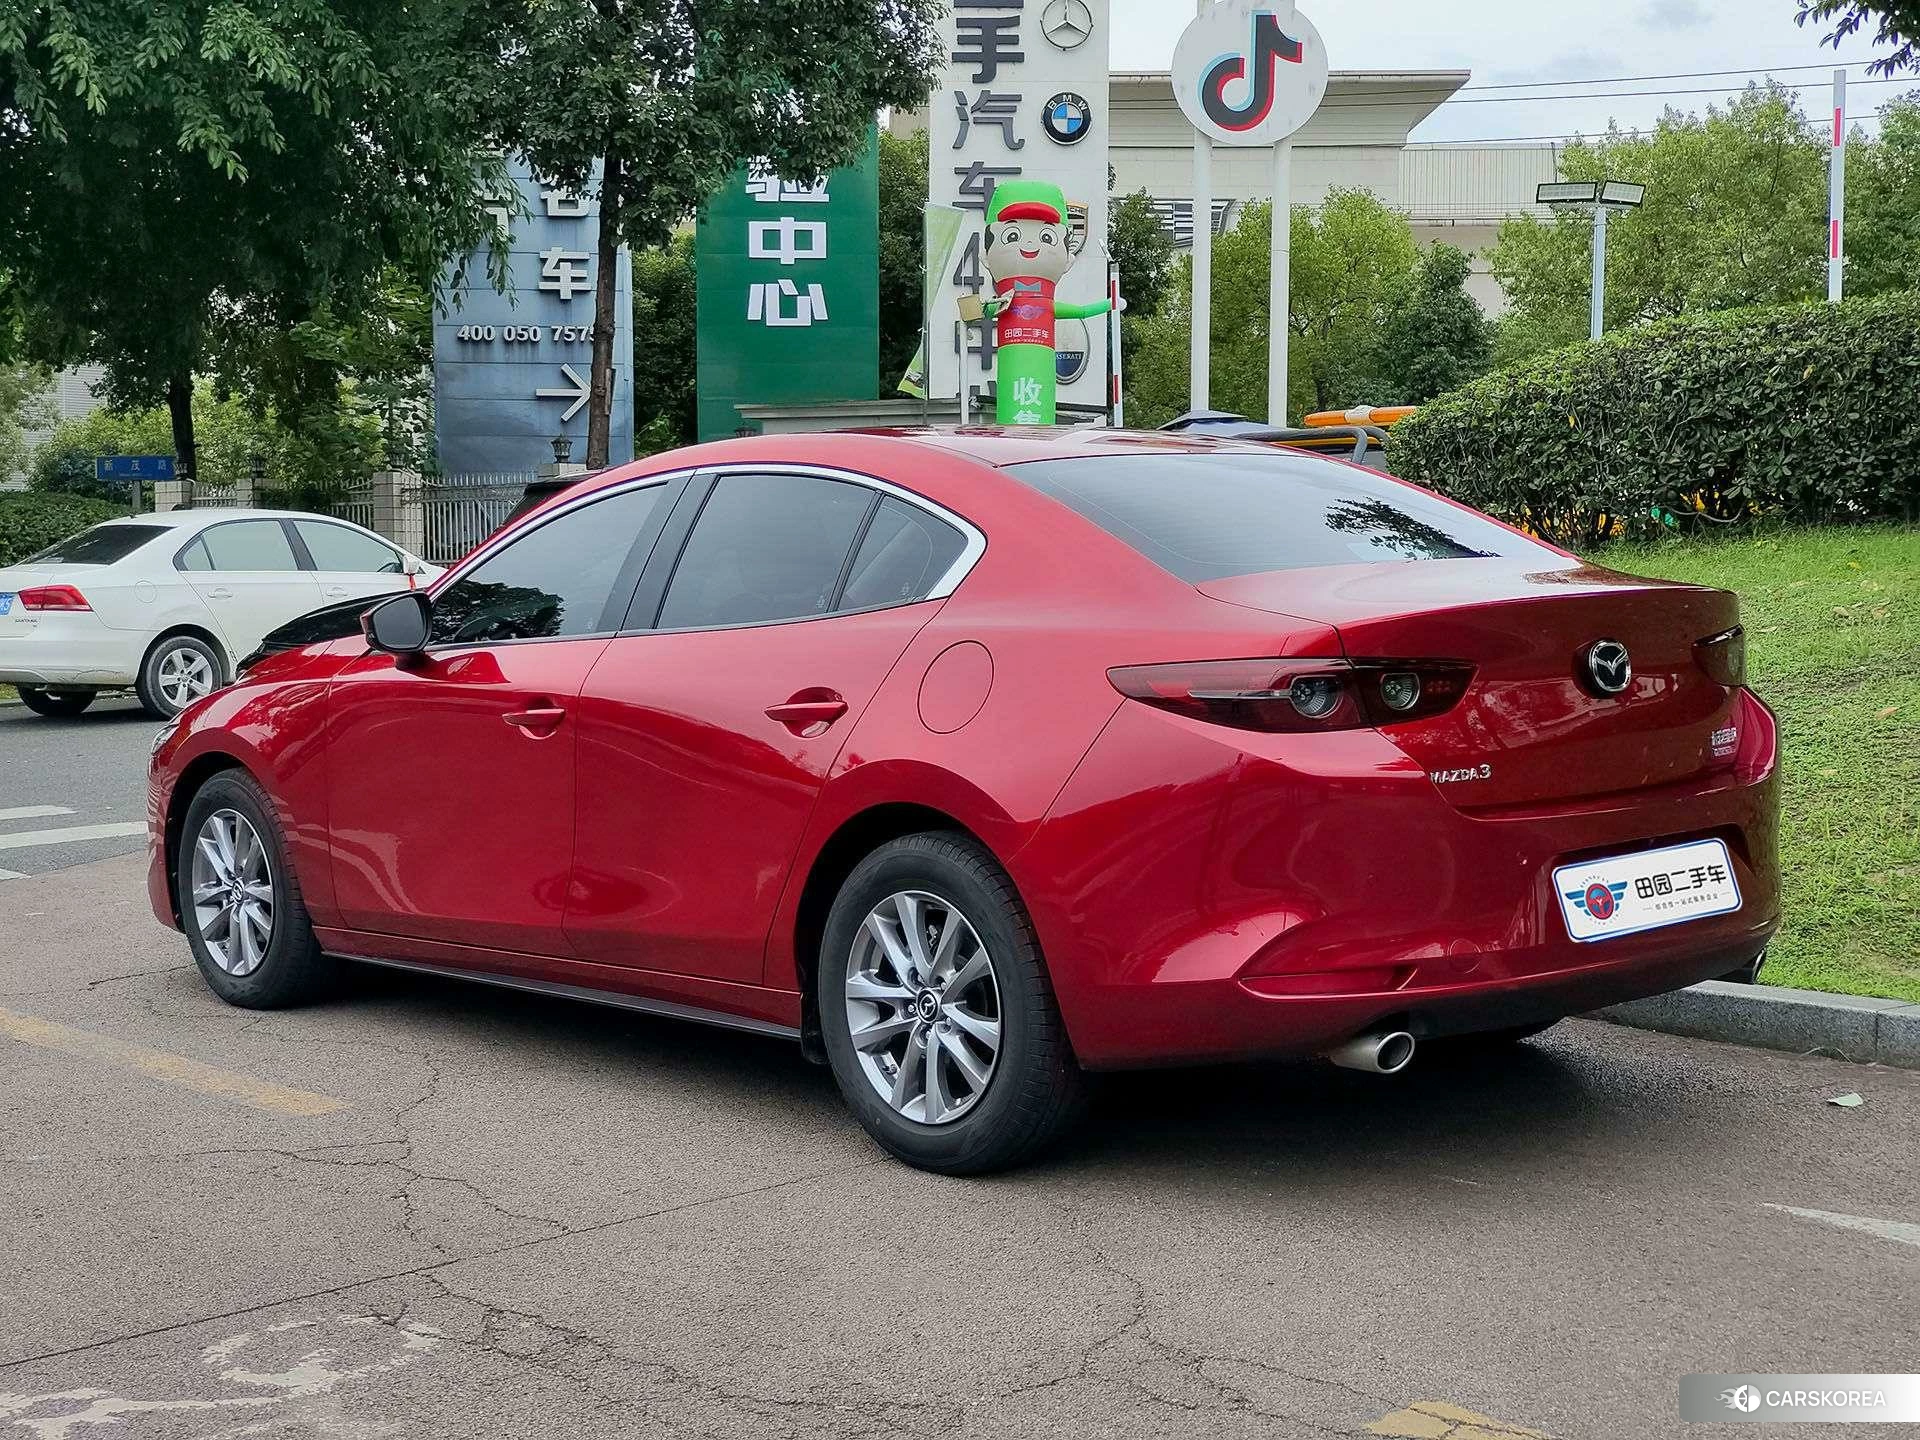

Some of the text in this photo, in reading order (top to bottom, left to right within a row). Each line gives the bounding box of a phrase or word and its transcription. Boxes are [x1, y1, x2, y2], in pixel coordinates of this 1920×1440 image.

[1047, 94, 1088, 111] BMW
[457, 325, 496, 342] 400
[503, 325, 542, 342] 050
[1634, 864, 1727, 899] 田园二手车
